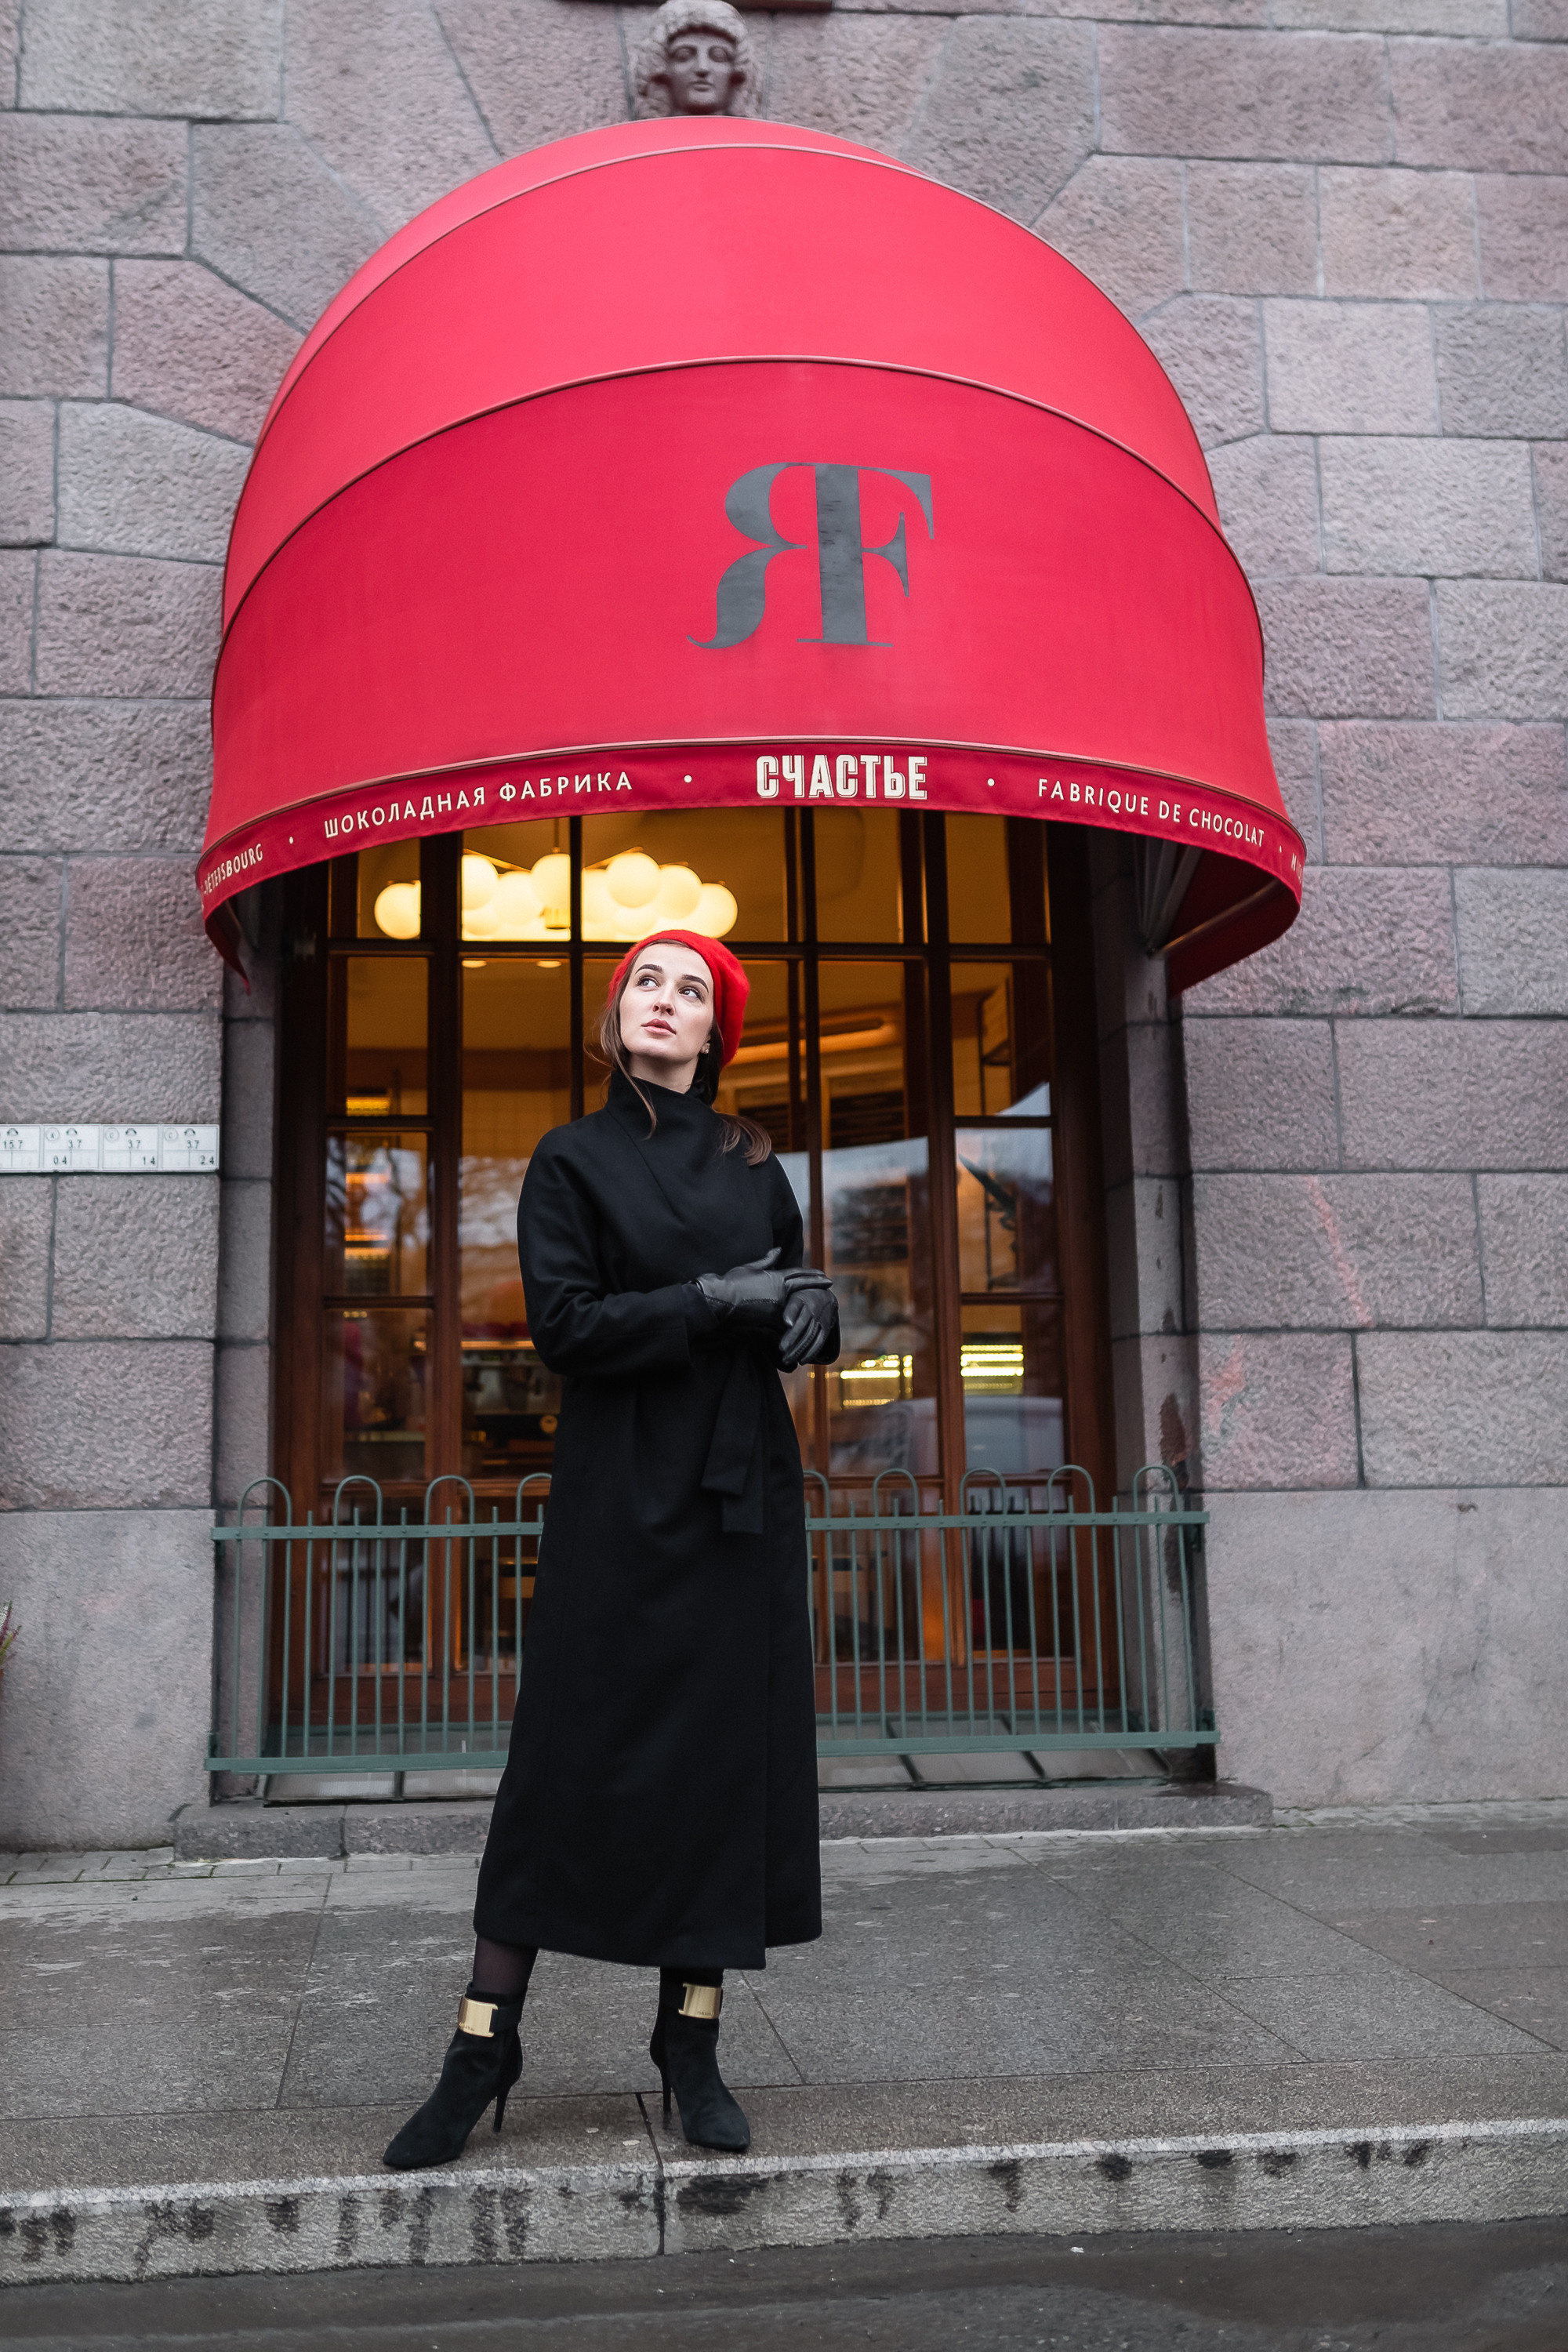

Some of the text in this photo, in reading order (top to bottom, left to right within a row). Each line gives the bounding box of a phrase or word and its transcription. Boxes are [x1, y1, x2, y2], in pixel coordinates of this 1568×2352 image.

[324, 771, 633, 838] ШОКОЛАДНАЯ ФАБРИКА
[755, 754, 928, 800] СЧАСТЬЕ
[1038, 779, 1265, 848] FABRIQUE DE CHOCOLAT
